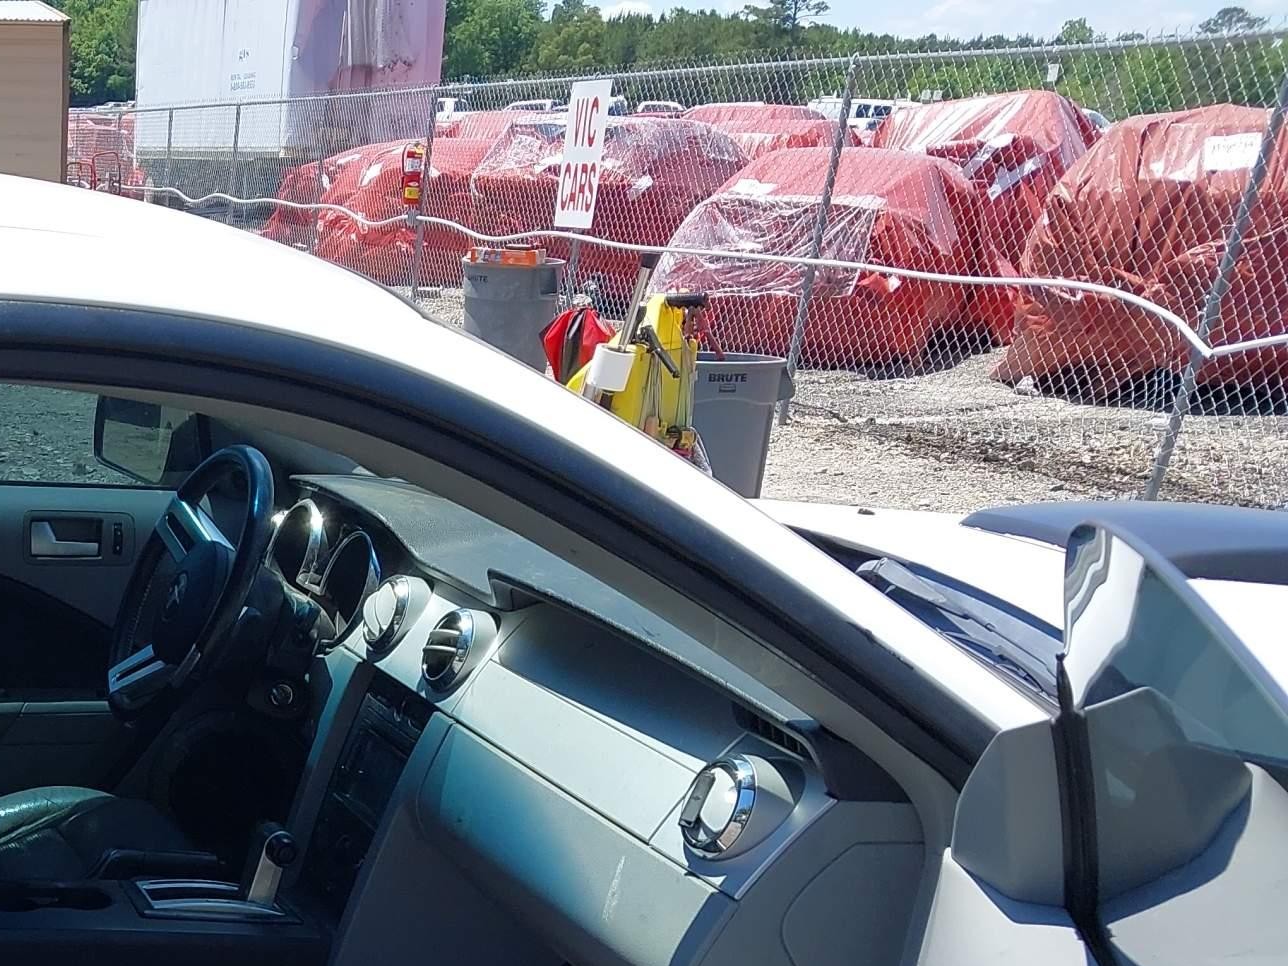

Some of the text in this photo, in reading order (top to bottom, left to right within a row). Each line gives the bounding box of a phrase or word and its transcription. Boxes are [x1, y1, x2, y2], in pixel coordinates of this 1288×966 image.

[574, 96, 600, 148] VIC
[560, 162, 597, 212] CARS
[708, 373, 748, 383] BRUTE
